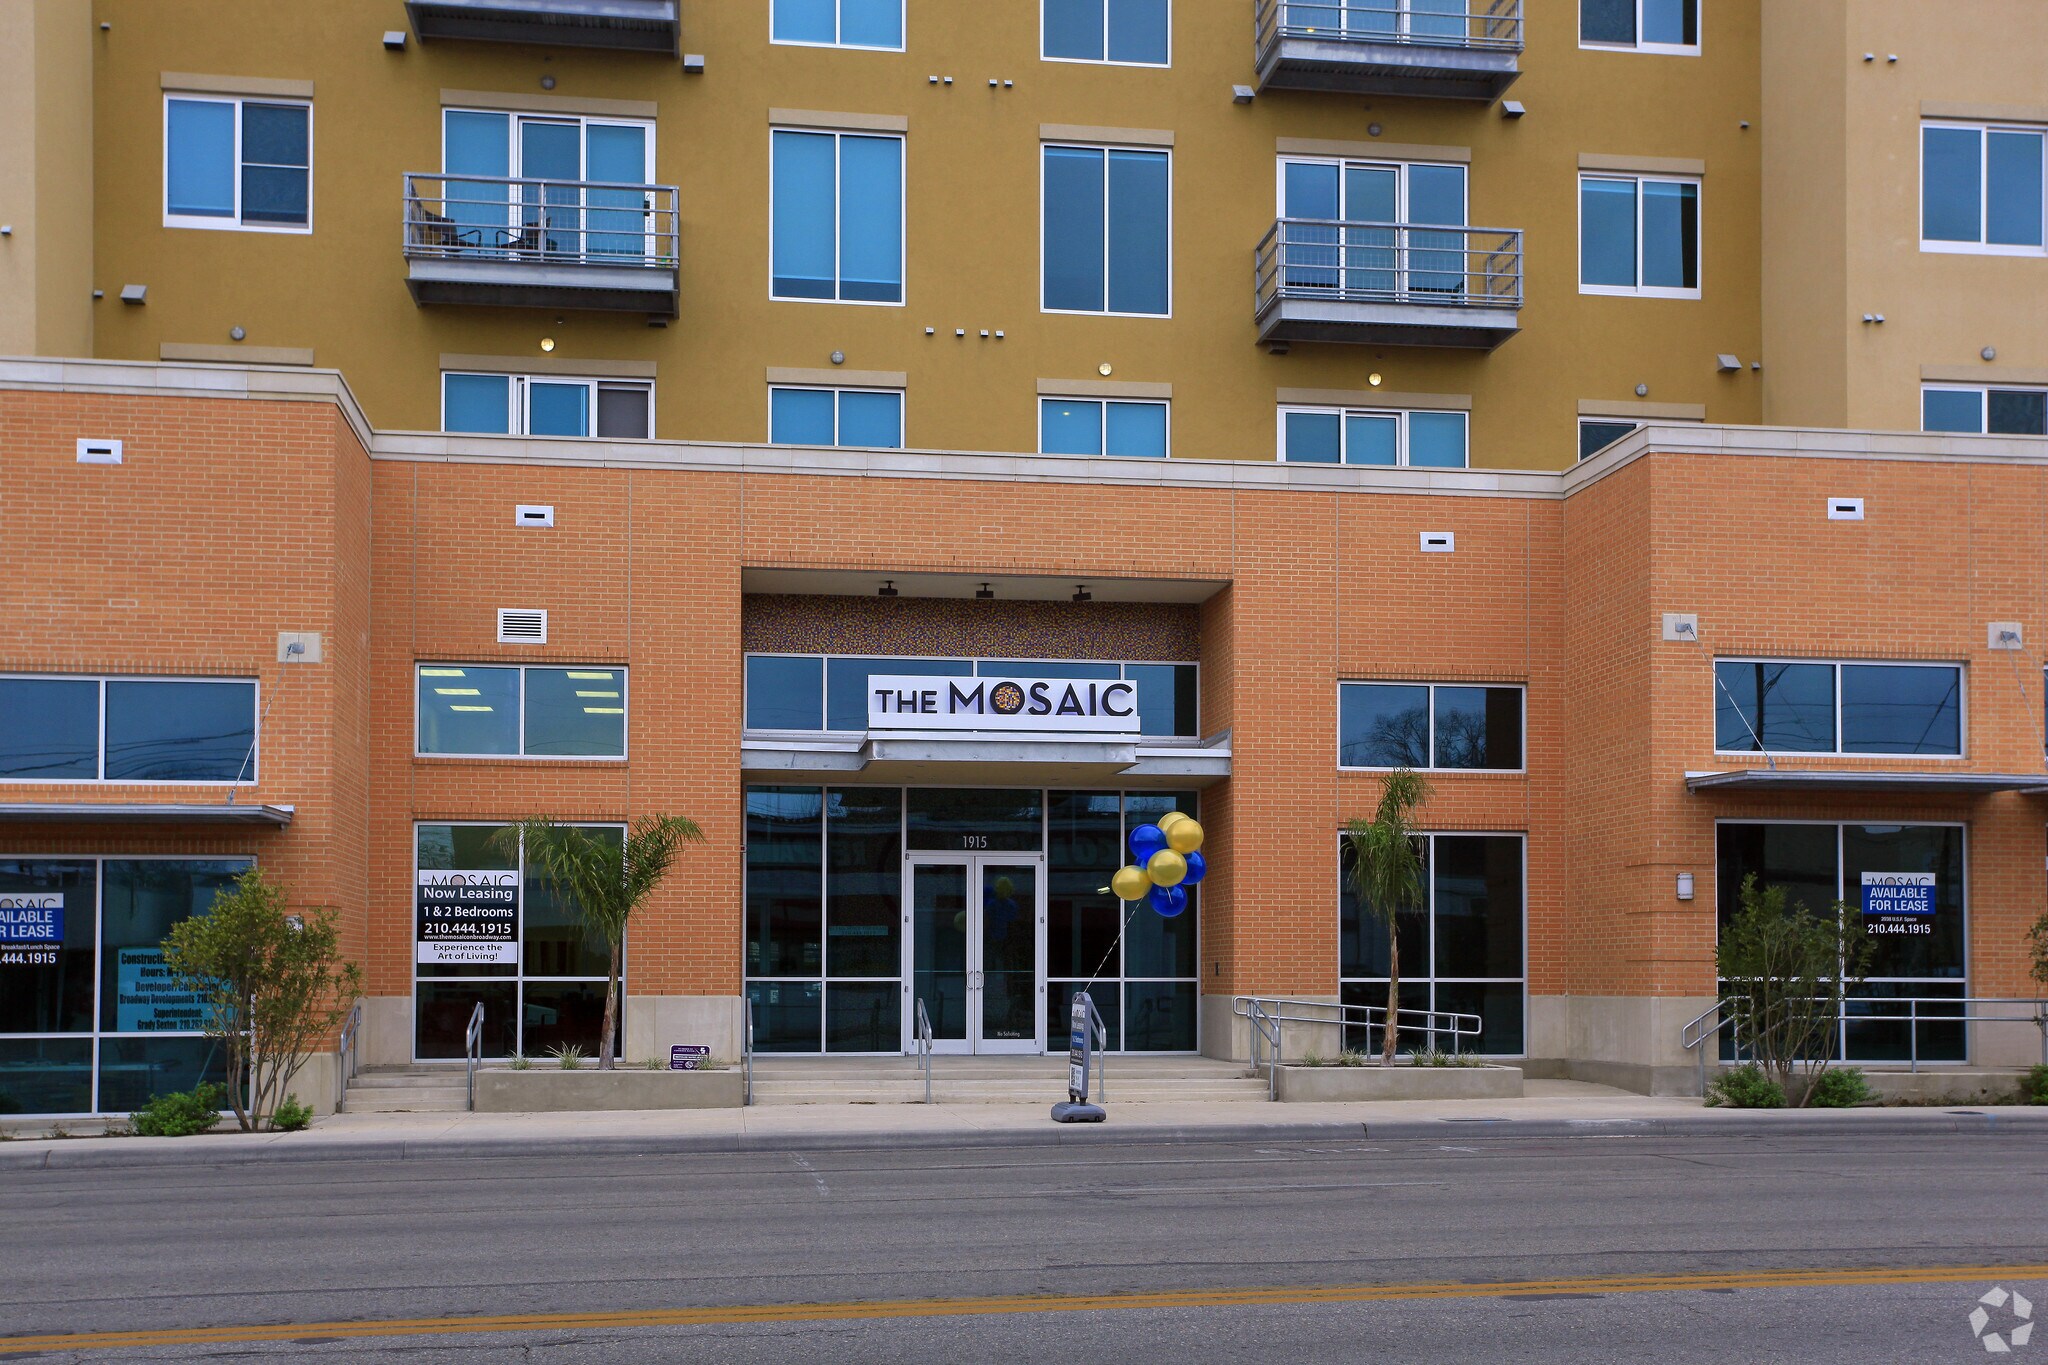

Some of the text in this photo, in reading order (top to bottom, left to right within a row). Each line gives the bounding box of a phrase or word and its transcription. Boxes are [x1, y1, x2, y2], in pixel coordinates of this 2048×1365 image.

[875, 681, 1134, 716] THE MOSAIC
[963, 835, 987, 848] 1915
[431, 874, 514, 886] MOSAIC
[424, 887, 513, 902] Now Leasing
[1870, 887, 1928, 899] AVAILABLE
[0, 898, 56, 908] OSAIC
[1869, 900, 1929, 911] FOR LEASE
[0, 910, 53, 923] AILABLE
[424, 906, 514, 917] 1 & 2 Bedrooms
[11, 925, 54, 938] LEASE
[424, 923, 511, 934] 210.444.1915
[1868, 924, 1931, 934] 210.444.1915
[433, 943, 503, 952] Experience the
[0, 952, 56, 964] .444.1915
[437, 952, 498, 961] Art of Living!
[140, 967, 165, 978] Hours:
